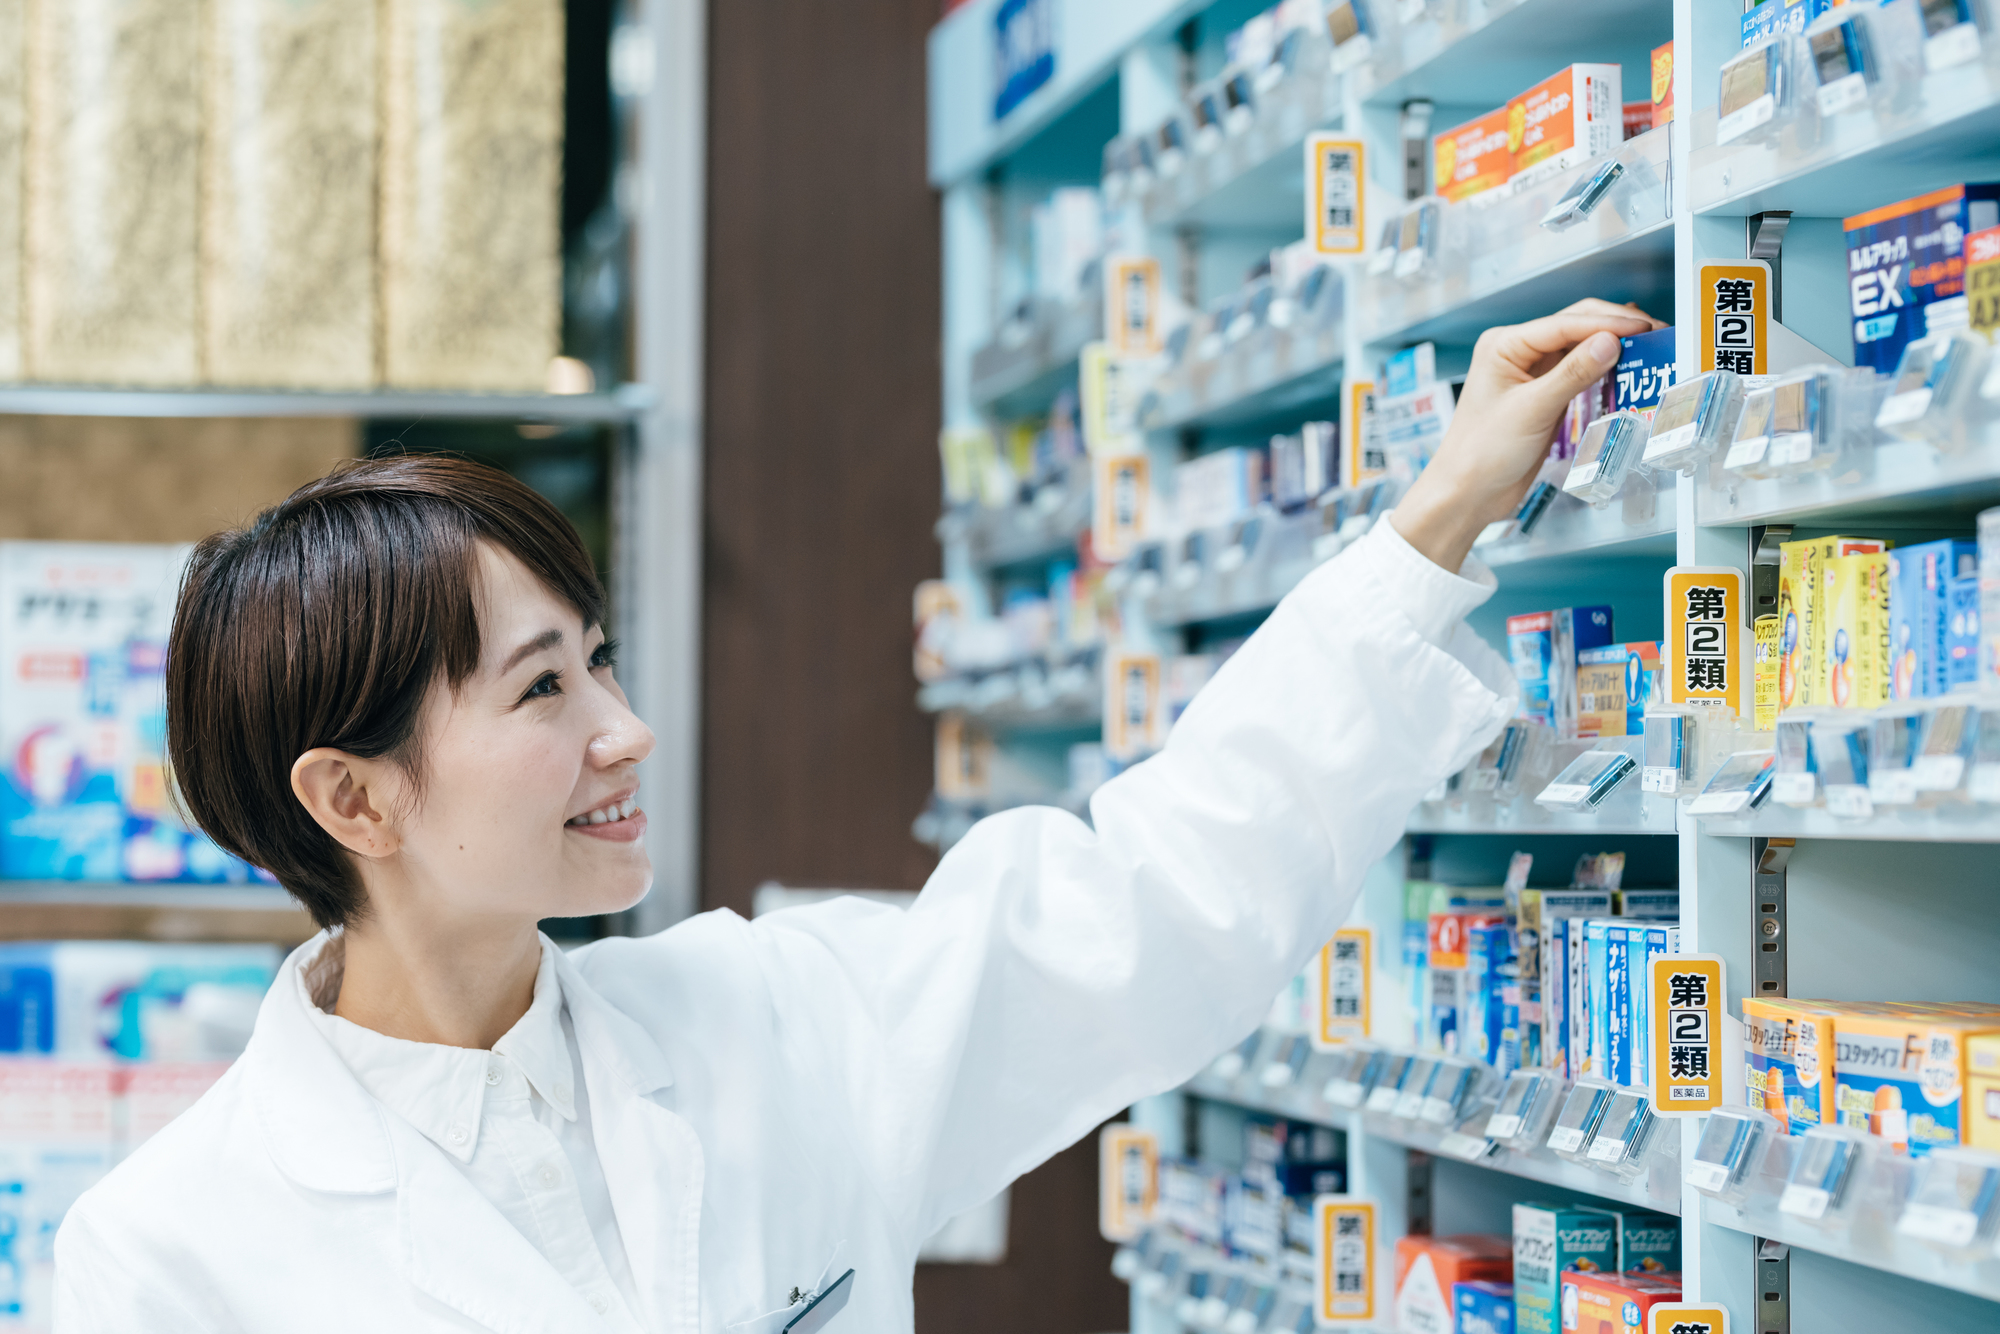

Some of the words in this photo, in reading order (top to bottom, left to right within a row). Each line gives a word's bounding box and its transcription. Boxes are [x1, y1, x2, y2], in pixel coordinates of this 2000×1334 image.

[1851, 236, 1907, 272] ルルアタック
[1853, 265, 1904, 317] EX
[1716, 280, 1754, 375] 第2類
[1616, 361, 1677, 405] アレジオ
[1687, 587, 1727, 690] 第2類
[1670, 975, 1709, 1078] 第2類
[1673, 1088, 1706, 1098] 医薬品
